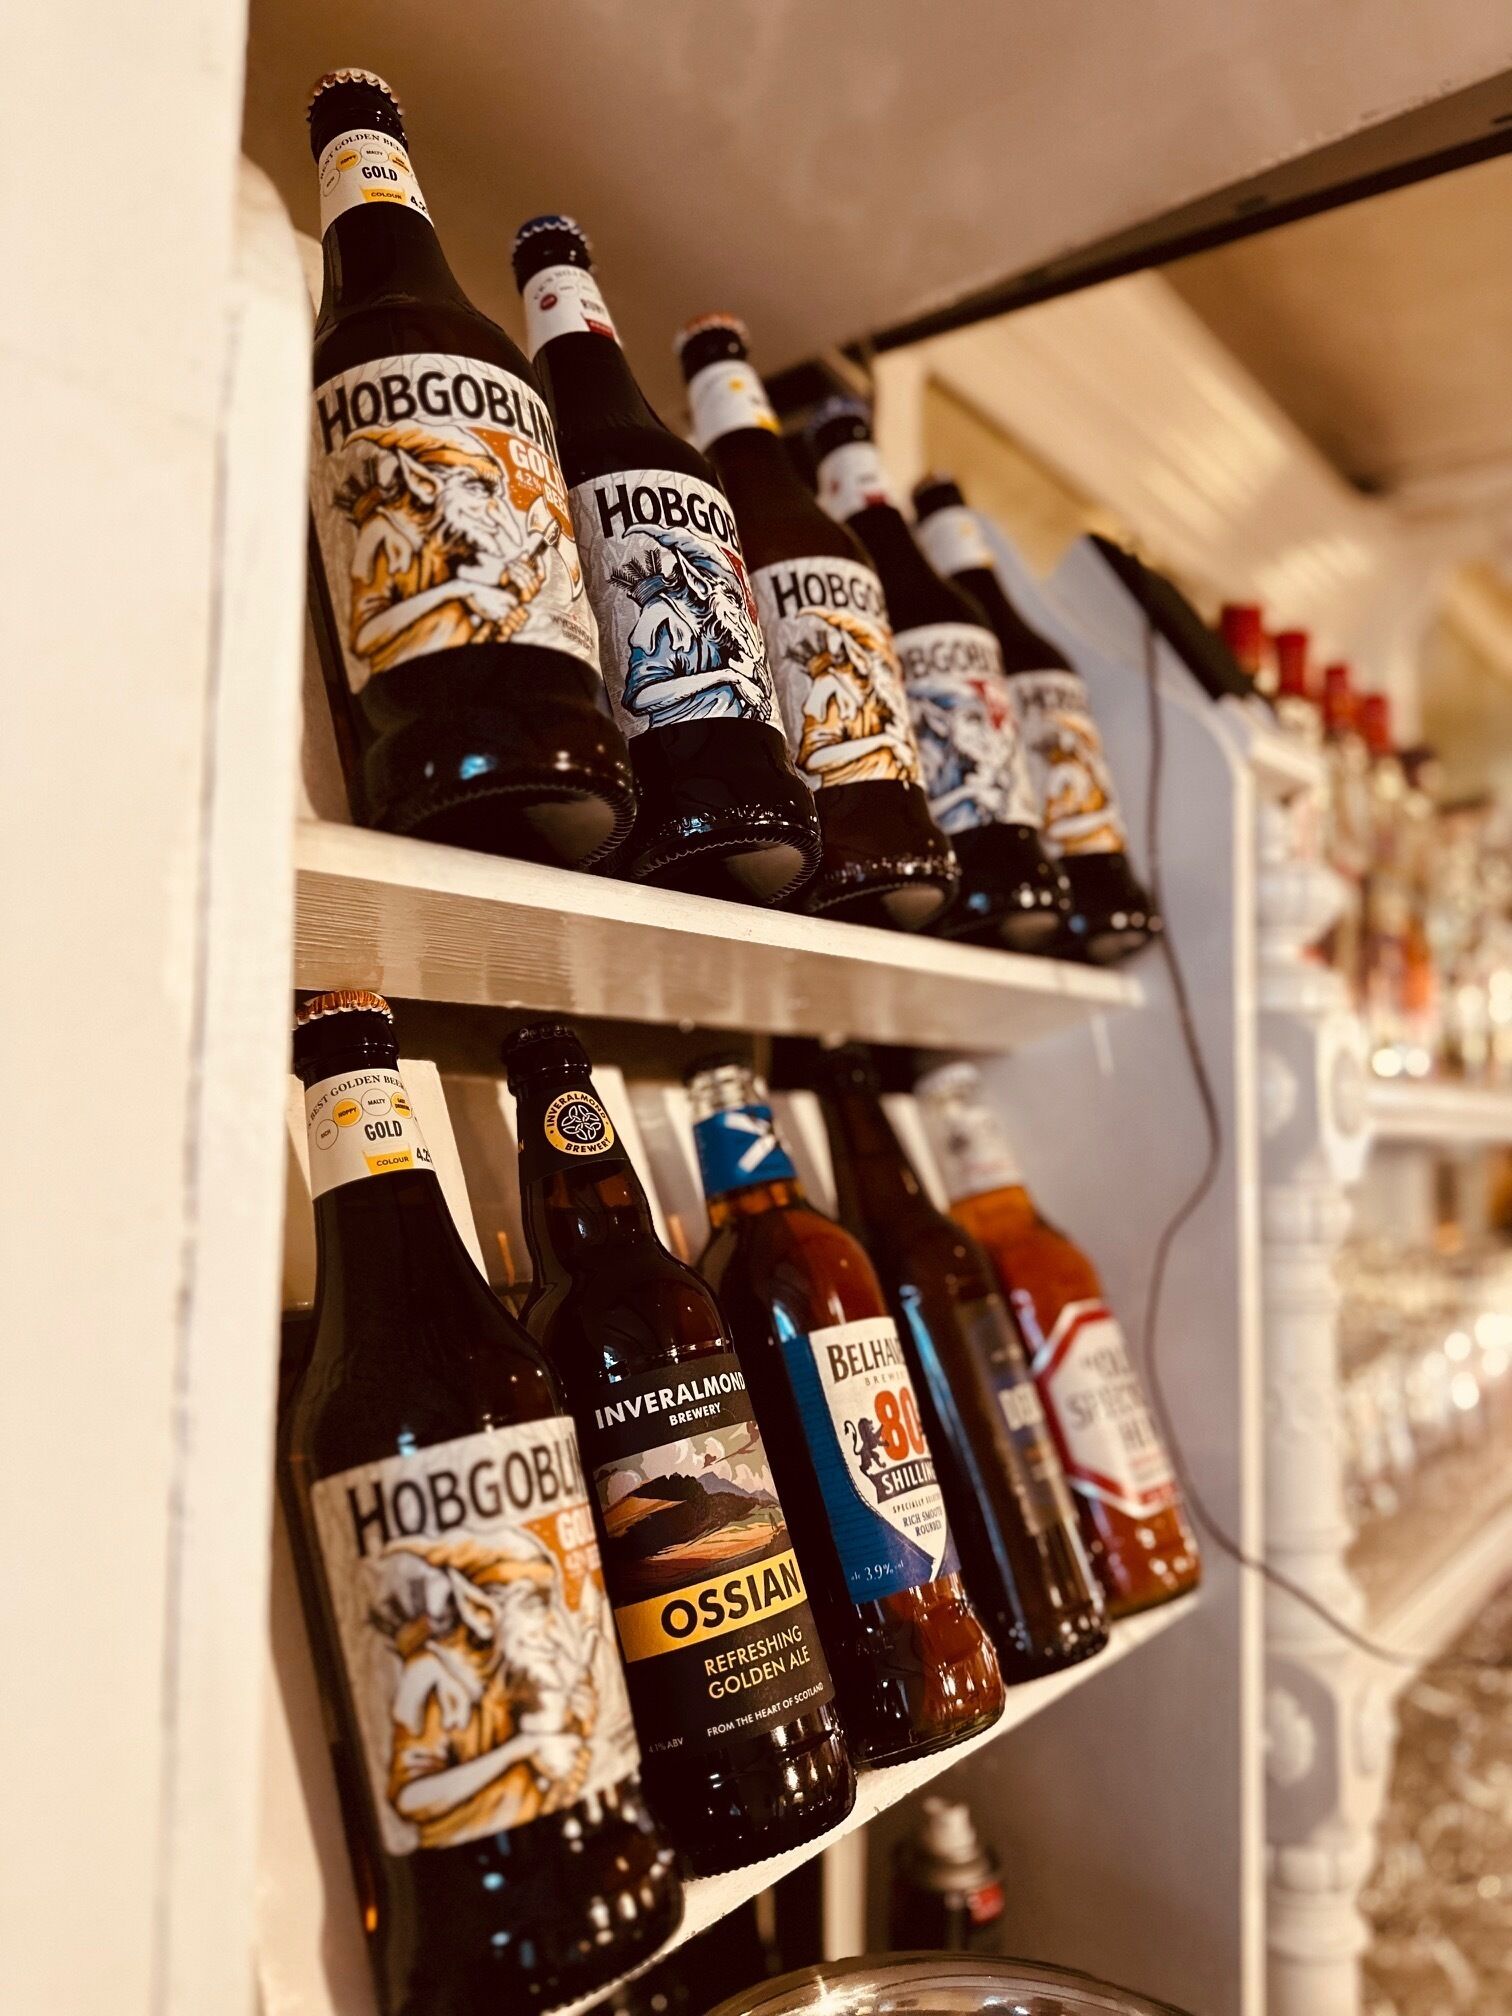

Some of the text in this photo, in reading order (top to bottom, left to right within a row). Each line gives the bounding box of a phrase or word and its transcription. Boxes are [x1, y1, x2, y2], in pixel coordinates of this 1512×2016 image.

[335, 133, 380, 151] GOLDEN
[361, 165, 398, 181] GOLD
[371, 192, 402, 200] COLOUR
[410, 195, 428, 212] 4.2
[317, 371, 559, 469] HOBGOBLIN
[594, 484, 741, 555] HOBGOB
[330, 1075, 381, 1097] GOLDEN
[547, 1093, 606, 1127] INVERALMOND
[364, 1120, 402, 1141] GOLD
[416, 1147, 433, 1164] 4.2
[565, 1137, 611, 1153] BREWERY
[376, 1156, 409, 1167] COLOUR
[826, 1338, 905, 1384] BELHA
[595, 1371, 746, 1429] INVERALMOND
[669, 1402, 721, 1426] BREWERY
[874, 1386, 925, 1461] 80
[881, 1461, 937, 1495] SHILLIN
[903, 1514, 921, 1527] RICH
[661, 1558, 801, 1638] OSSIAN
[704, 1625, 803, 1676] REFRESHING
[708, 1645, 811, 1699] GOLDEN ALE
[707, 1682, 824, 1737] FROM THE HEART OF SCOTLAND
[667, 1737, 684, 1749] ABV
